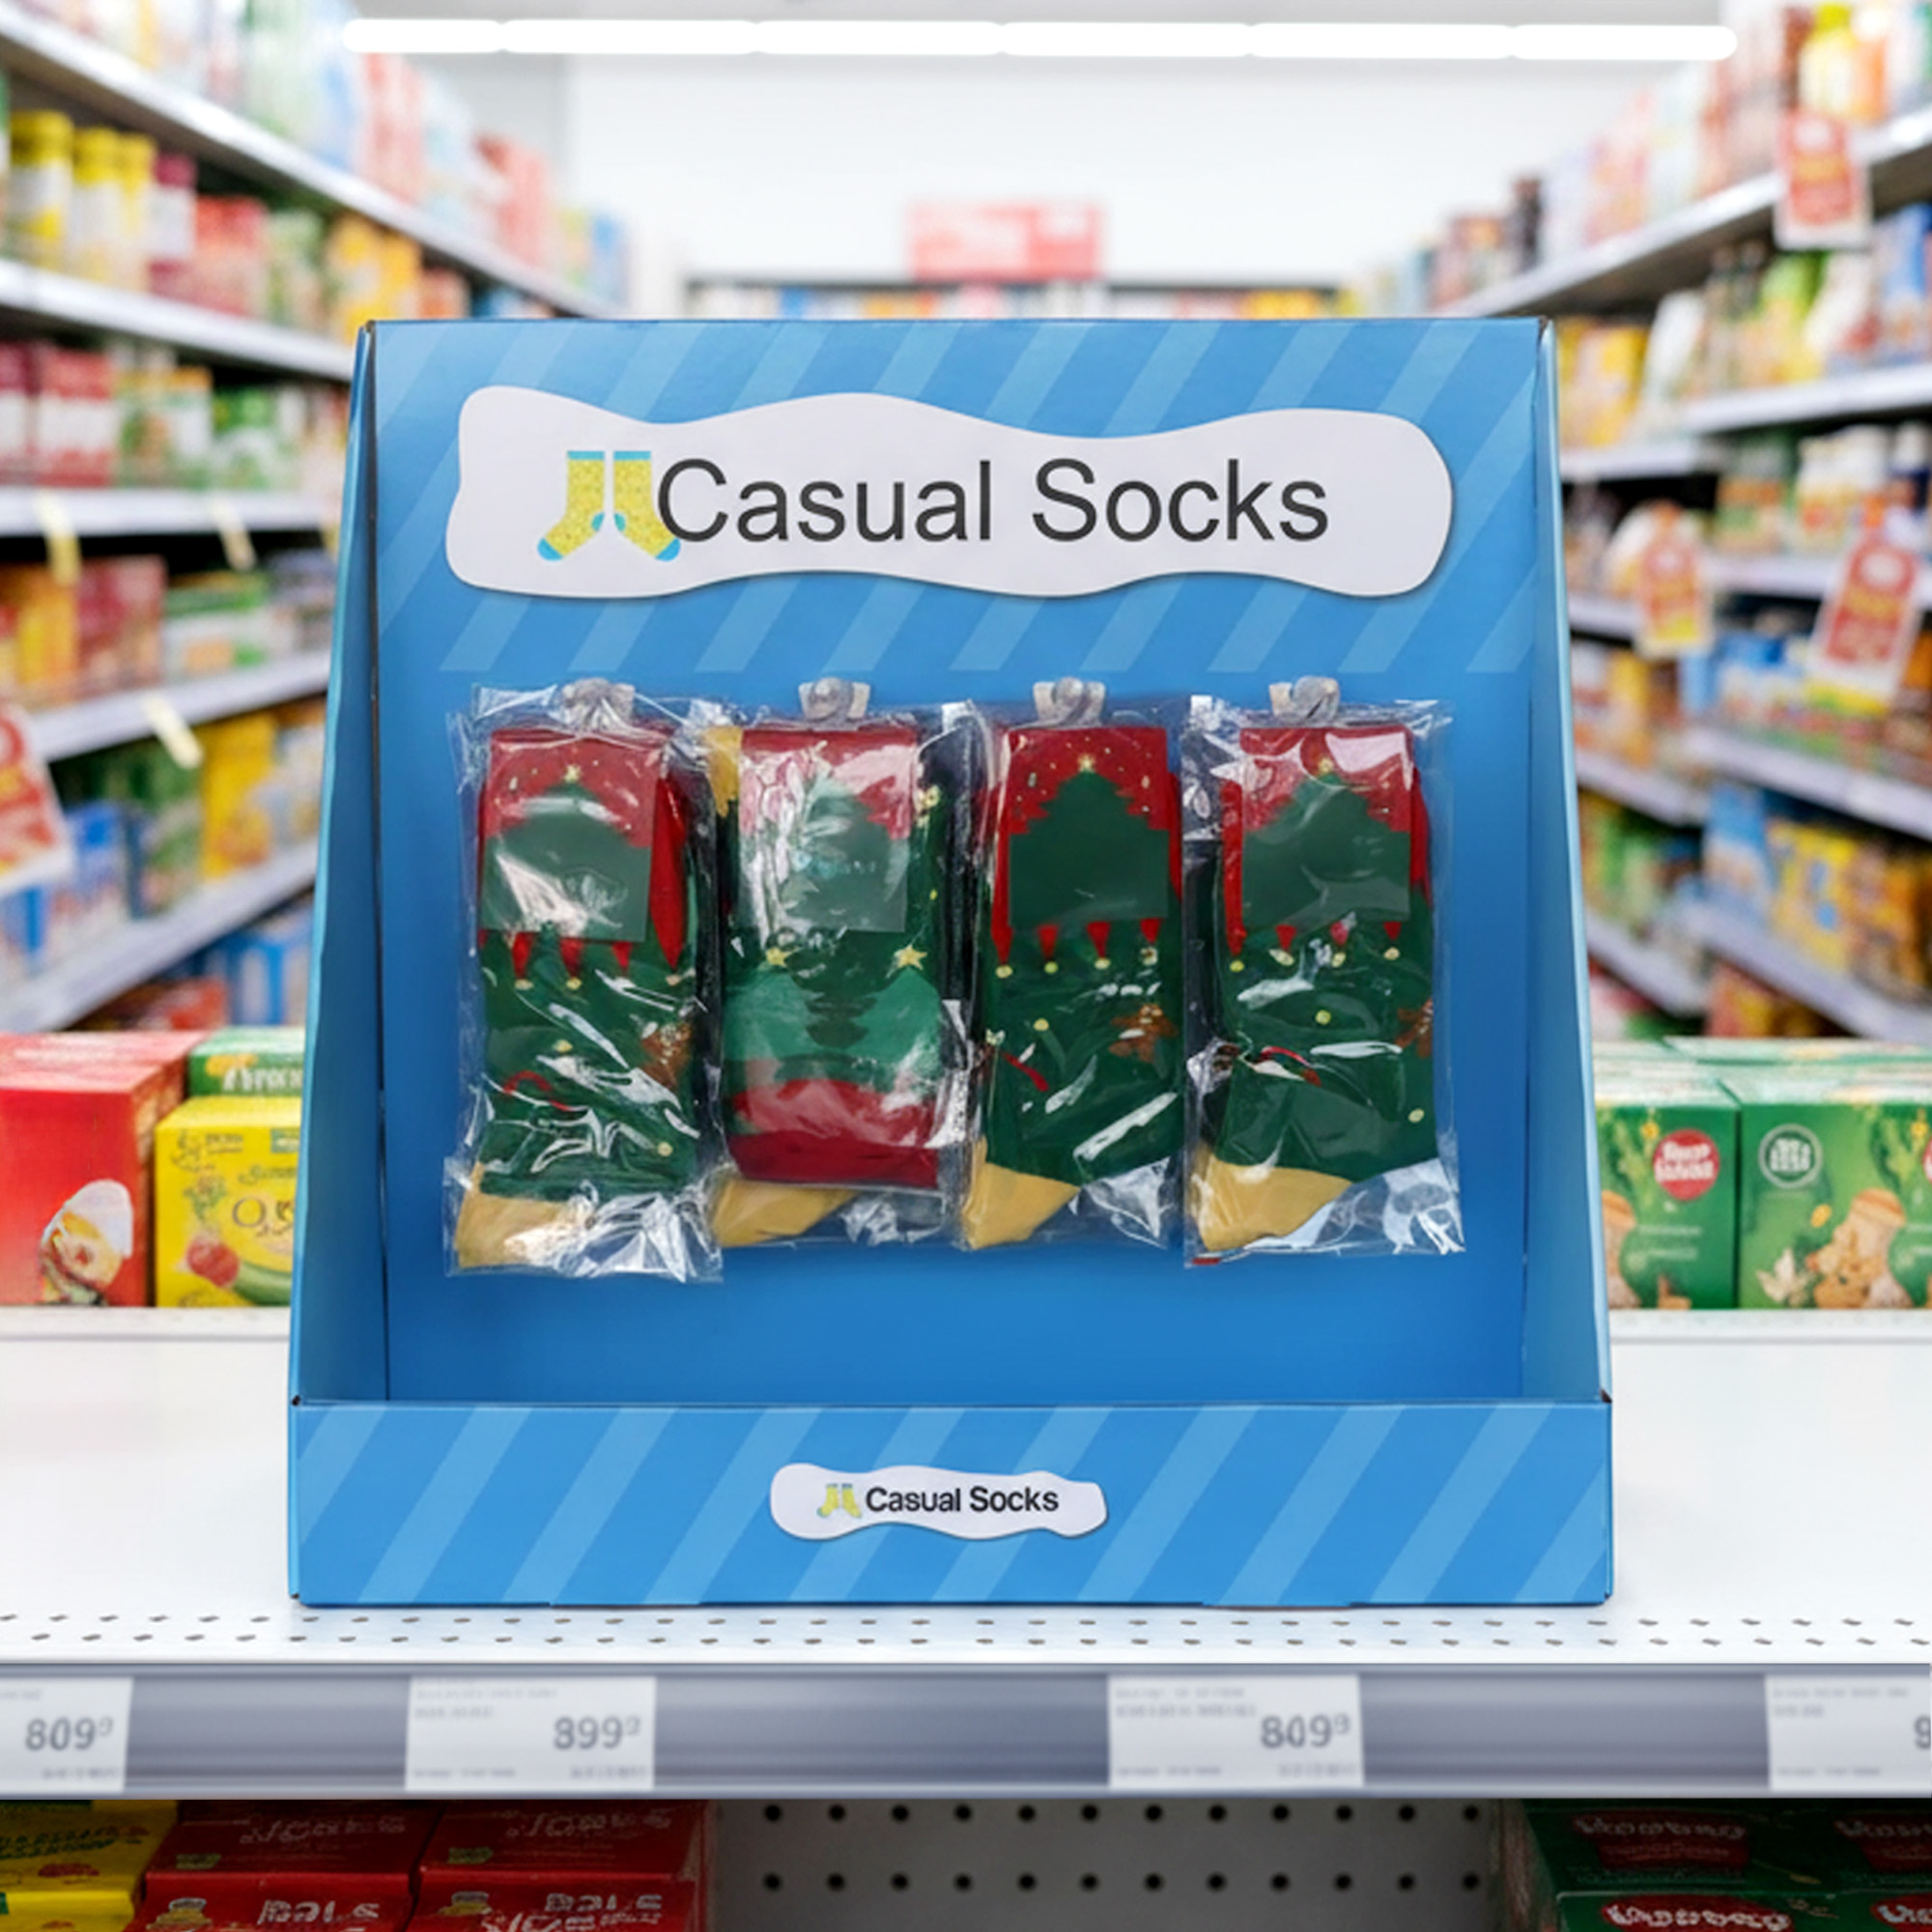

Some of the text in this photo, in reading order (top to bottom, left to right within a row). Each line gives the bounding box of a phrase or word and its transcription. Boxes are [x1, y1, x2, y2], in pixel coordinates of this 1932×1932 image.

[657, 458, 1329, 543] Casual Socks
[866, 1485, 1060, 1513] Casual Socks
